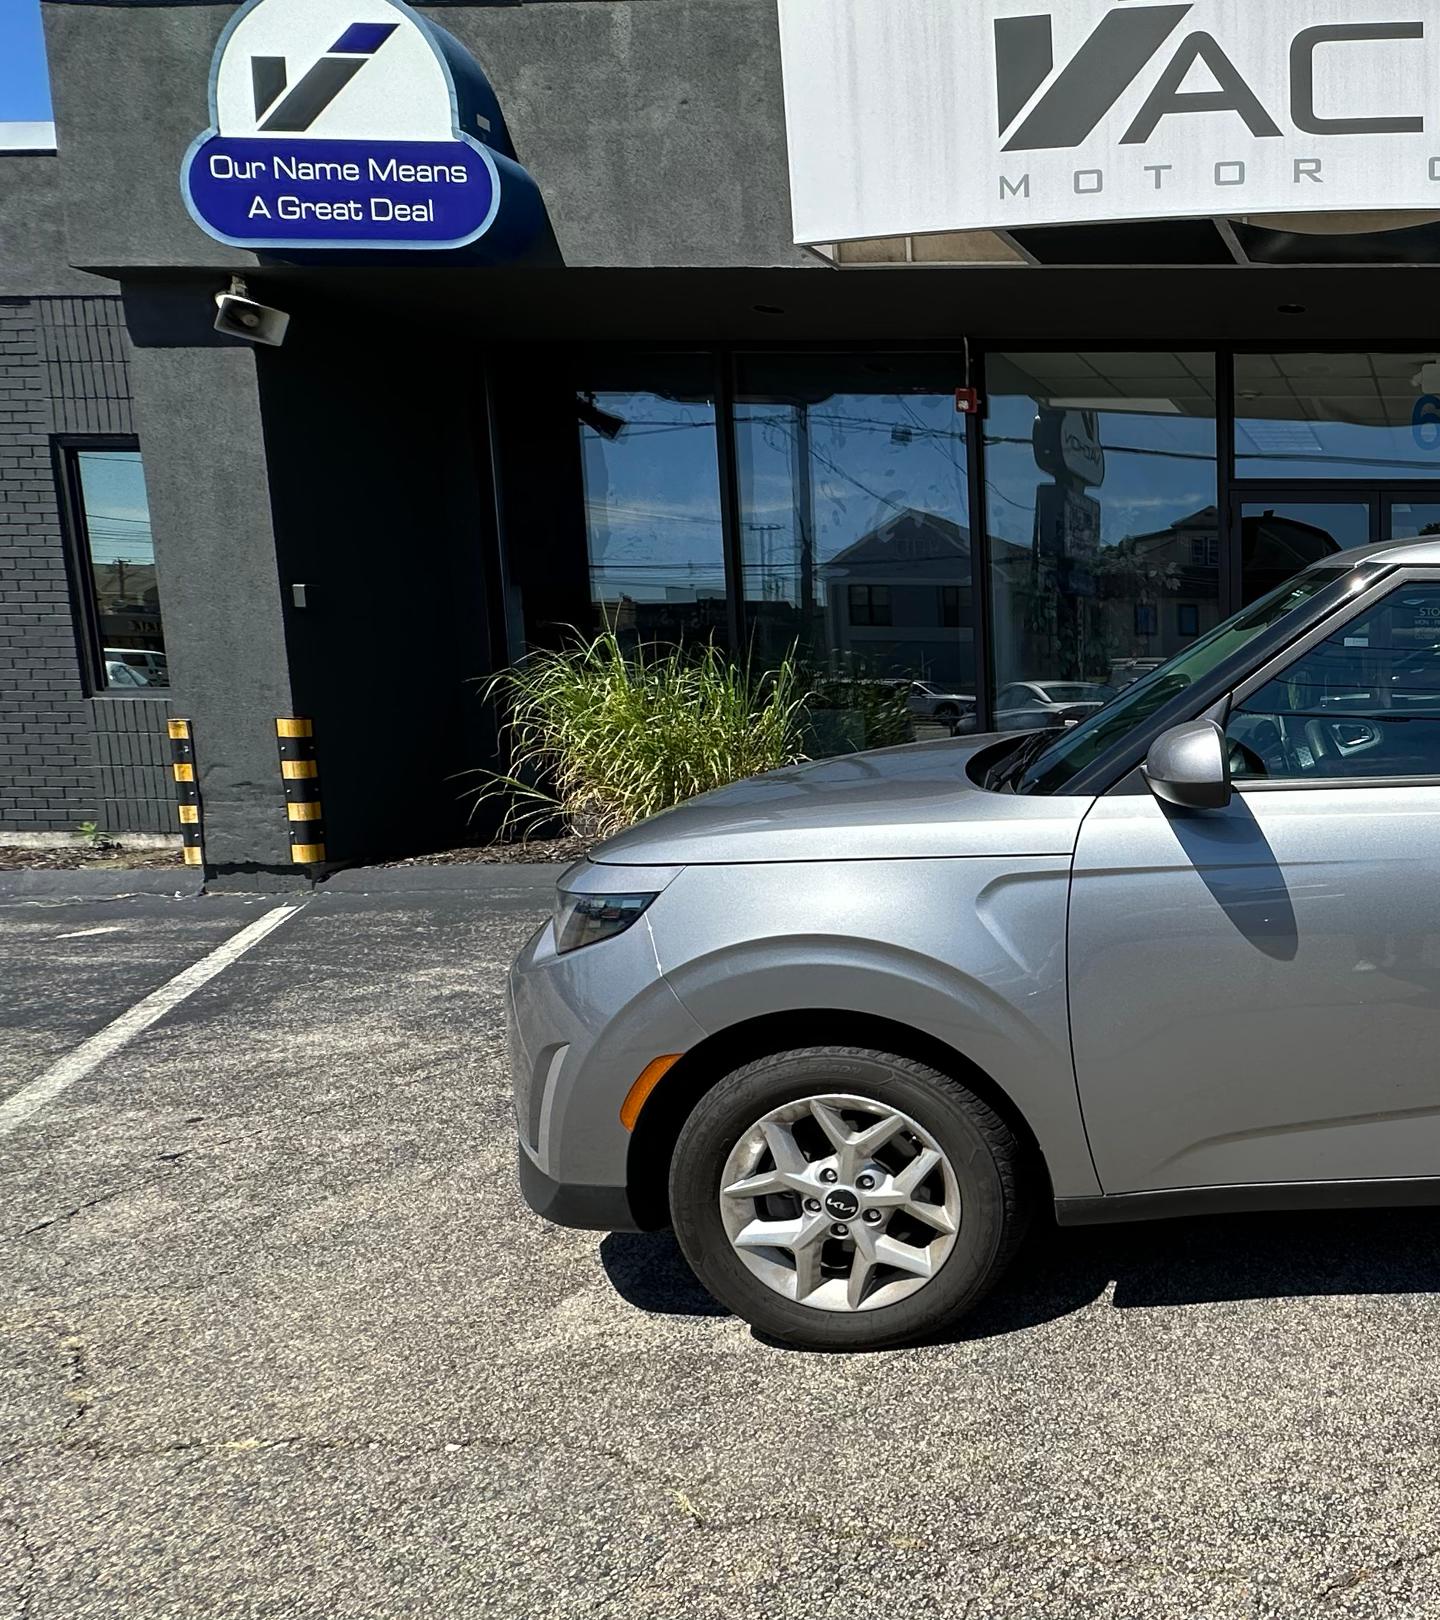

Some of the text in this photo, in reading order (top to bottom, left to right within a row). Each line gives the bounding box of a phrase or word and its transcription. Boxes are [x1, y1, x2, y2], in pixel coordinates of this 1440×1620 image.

[209, 155, 468, 184] Our Name Means
[999, 158, 1324, 199] MOTOR
[248, 196, 434, 222] A Great Deal
